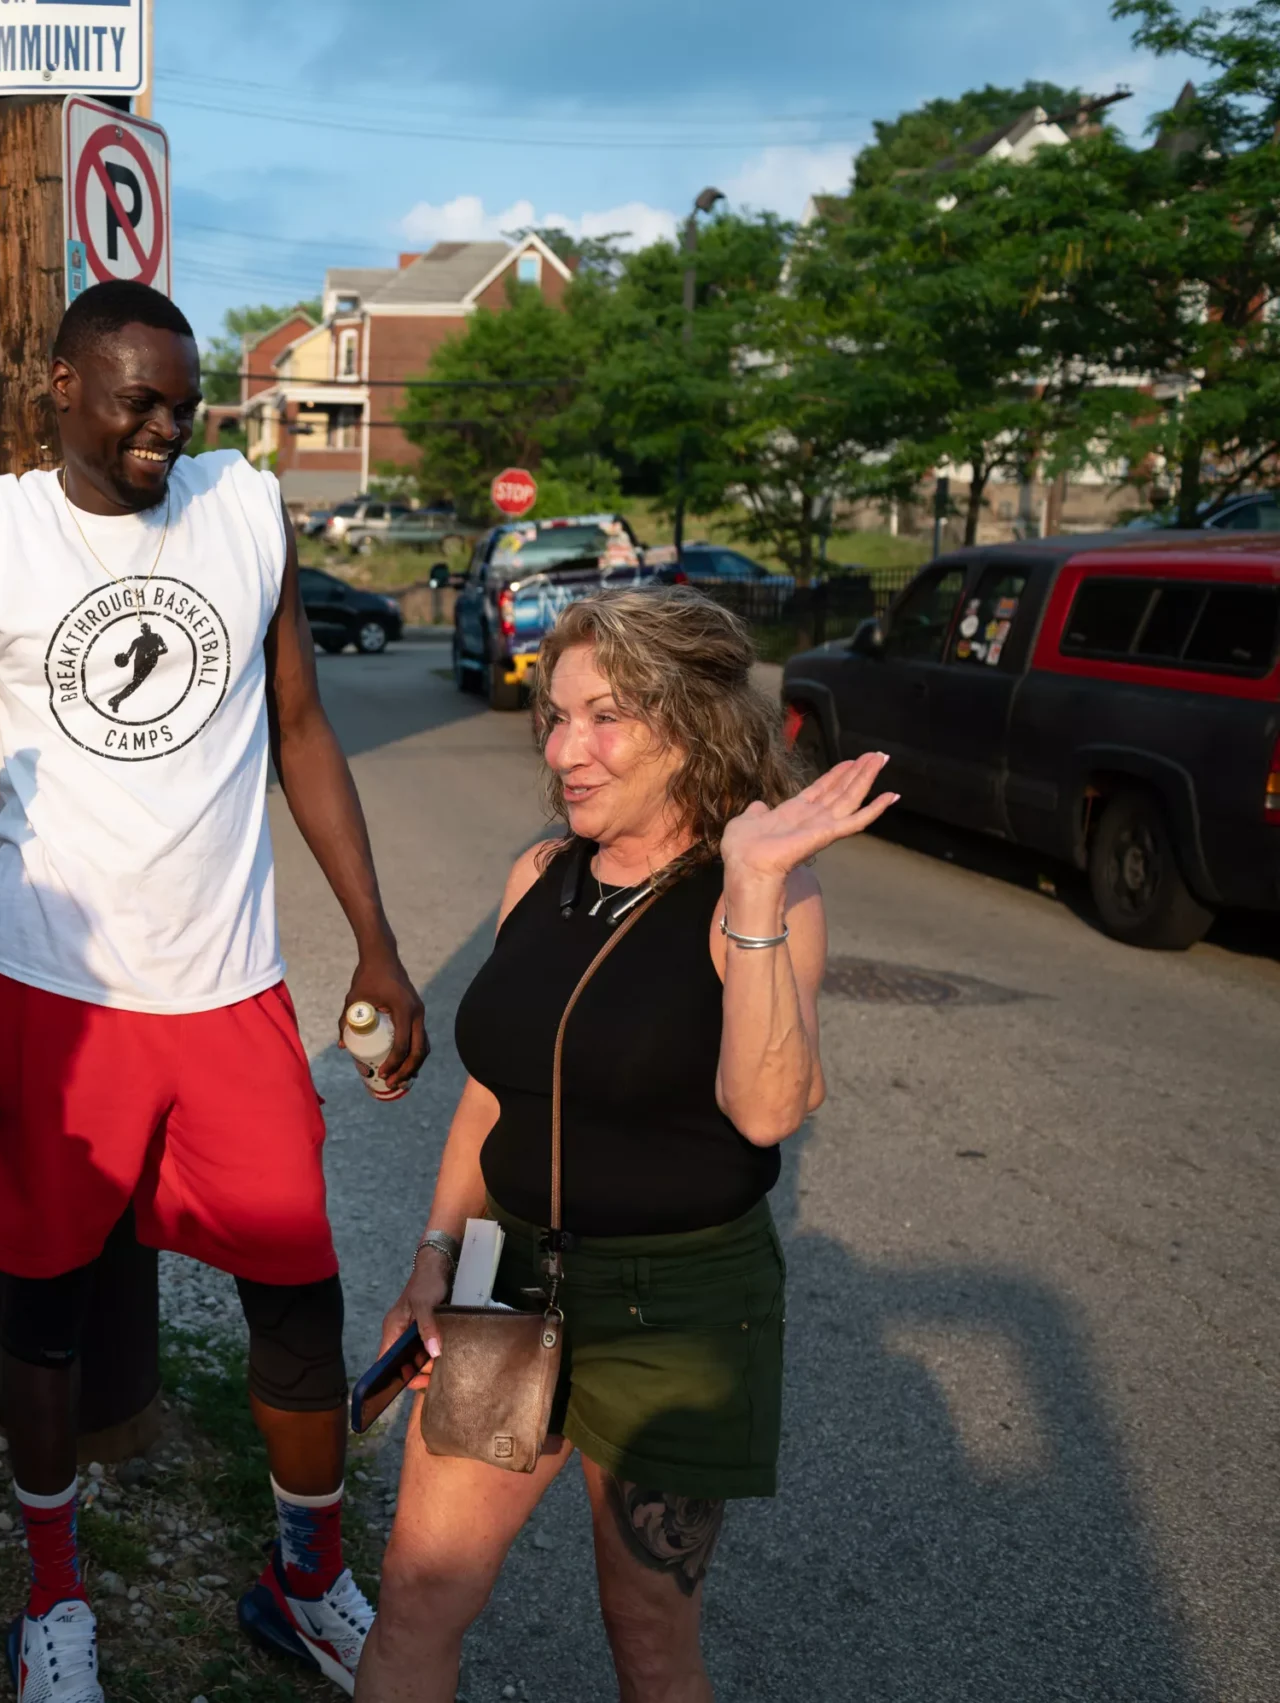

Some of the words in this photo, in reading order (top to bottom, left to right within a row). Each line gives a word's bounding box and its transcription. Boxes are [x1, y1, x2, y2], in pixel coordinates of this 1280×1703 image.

[496, 483, 534, 502] STOP
[57, 588, 145, 702] BREAKTHROUGH
[154, 587, 219, 687] BASKETBALL
[105, 725, 173, 750] CAMPS
